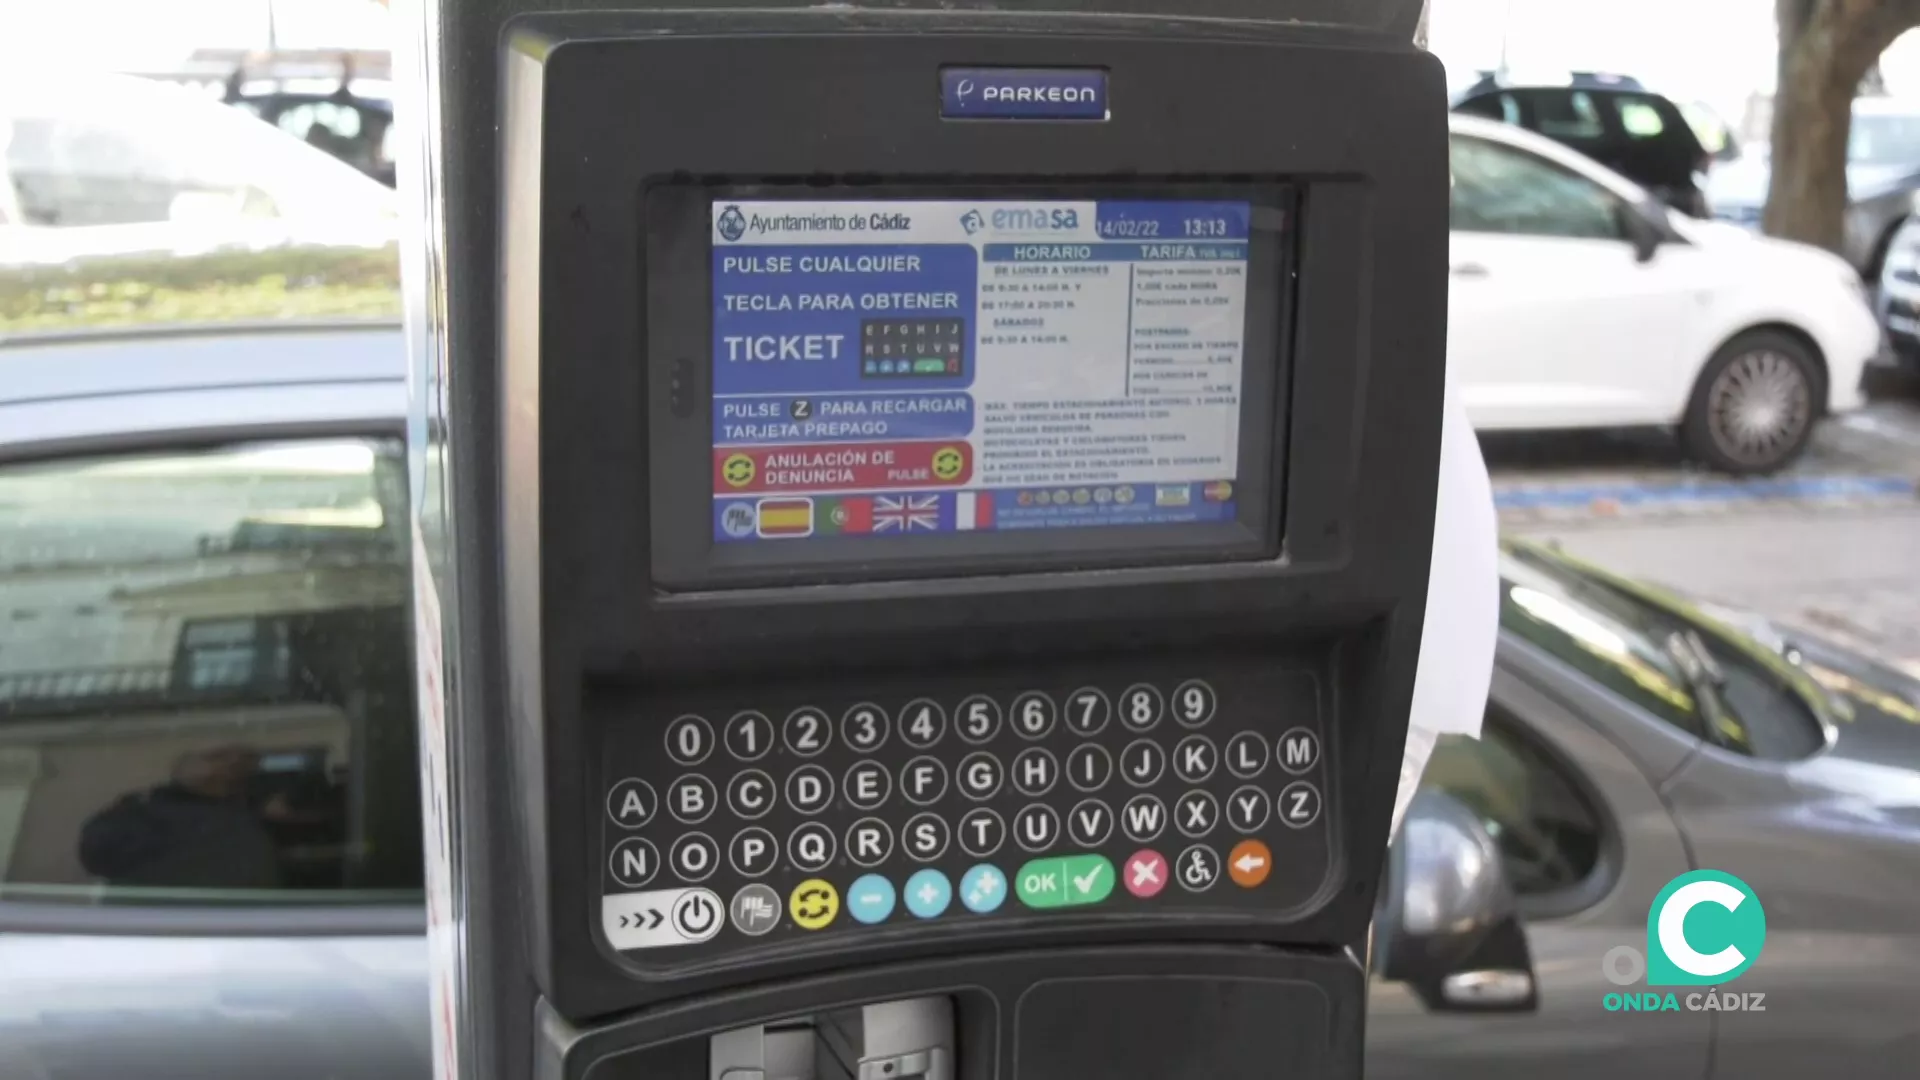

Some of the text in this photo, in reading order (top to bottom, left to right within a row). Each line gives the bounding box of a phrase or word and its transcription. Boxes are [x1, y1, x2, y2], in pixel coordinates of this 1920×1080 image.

[983, 86, 1095, 102] PARKEON
[750, 212, 911, 233] Ayuntamiento de Cádiz
[991, 208, 1078, 230] emasa
[1097, 219, 1227, 236] 14/02/22 13:13
[1014, 245, 1091, 260] HORARIO
[1140, 244, 1196, 259] TARIFA
[723, 255, 921, 273] PULSE CUALQUIER
[724, 292, 958, 311] TECLA PARA OBTENER
[724, 334, 844, 361] TICKET
[723, 398, 967, 418] PULSE Z PARA RECARGAR
[724, 420, 887, 439] TARJETA PREPAGO
[765, 450, 895, 469] ANULACIÓN DE
[765, 468, 929, 485] DENUNCIA PULSE
[679, 687, 1204, 757] 0 1 2 3 4 5 6 7 8 9
[620, 737, 1310, 818] A B C D E F G H I J K L M
[623, 791, 1309, 877] N O P Q R S T U V W X Y Z
[1025, 873, 1057, 892] OK
